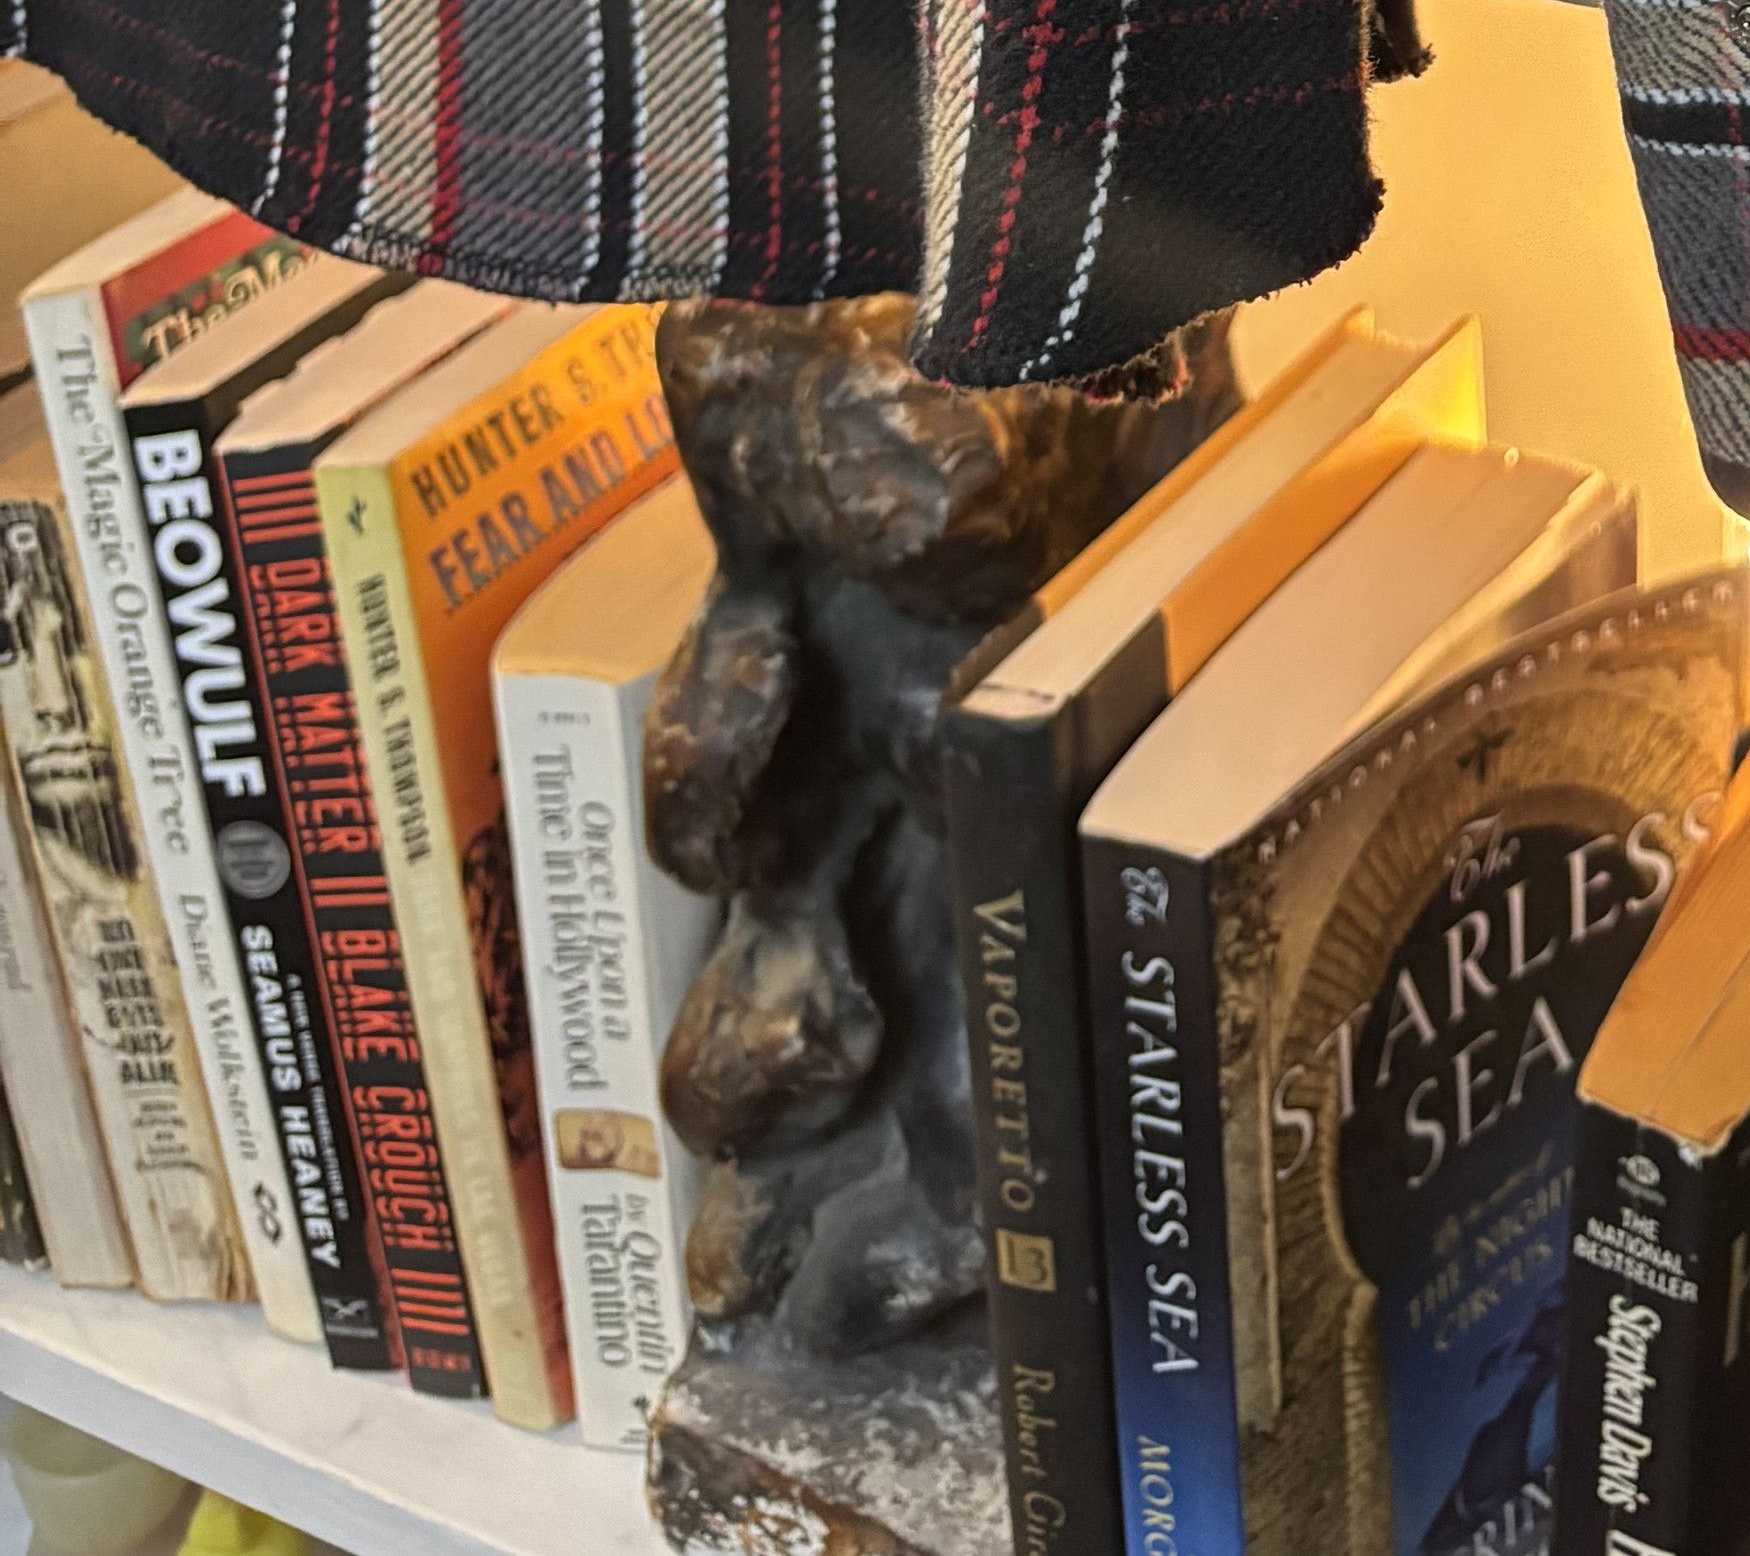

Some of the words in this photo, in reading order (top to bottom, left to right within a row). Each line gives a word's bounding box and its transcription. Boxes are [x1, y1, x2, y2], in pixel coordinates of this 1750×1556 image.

[410, 388, 565, 517] HUNTER
[428, 507, 538, 611] FEAR
[537, 436, 628, 518] AND
[55, 334, 97, 422] The
[76, 421, 137, 586] Magic
[107, 581, 168, 739] Orange
[143, 741, 190, 859] Tree
[134, 429, 266, 799] BEOWULF
[262, 557, 338, 674] DARK
[276, 692, 360, 854] MATTER
[531, 744, 576, 840] Time
[544, 850, 580, 881] in
[580, 802, 619, 899] Once
[179, 893, 218, 993] Diane
[328, 929, 415, 1063] BLAKE
[546, 892, 608, 1089] Hollywood
[574, 912, 628, 1007] Upon
[601, 1015, 630, 1041] a
[974, 892, 1036, 1214] VAPORETTO
[1406, 996, 1574, 1188] SEA
[240, 924, 301, 1091] SEAMUS
[279, 1105, 340, 1269] HEANEY
[1124, 951, 1189, 1248] STARLESS
[362, 1083, 448, 1253] CROUCH
[1620, 1206, 1660, 1242] THE
[580, 1194, 633, 1366] Tarantino
[617, 1231, 674, 1375] Quentin
[1573, 1233, 1698, 1303] BESTSELLER
[1587, 1217, 1685, 1276] NATIONAL
[1147, 1265, 1199, 1373] SEA
[1595, 1294, 1661, 1425] Stephen
[1013, 1363, 1056, 1477] Robert
[1597, 1419, 1653, 1513] Davis
[1022, 1490, 1070, 1556] Gir
